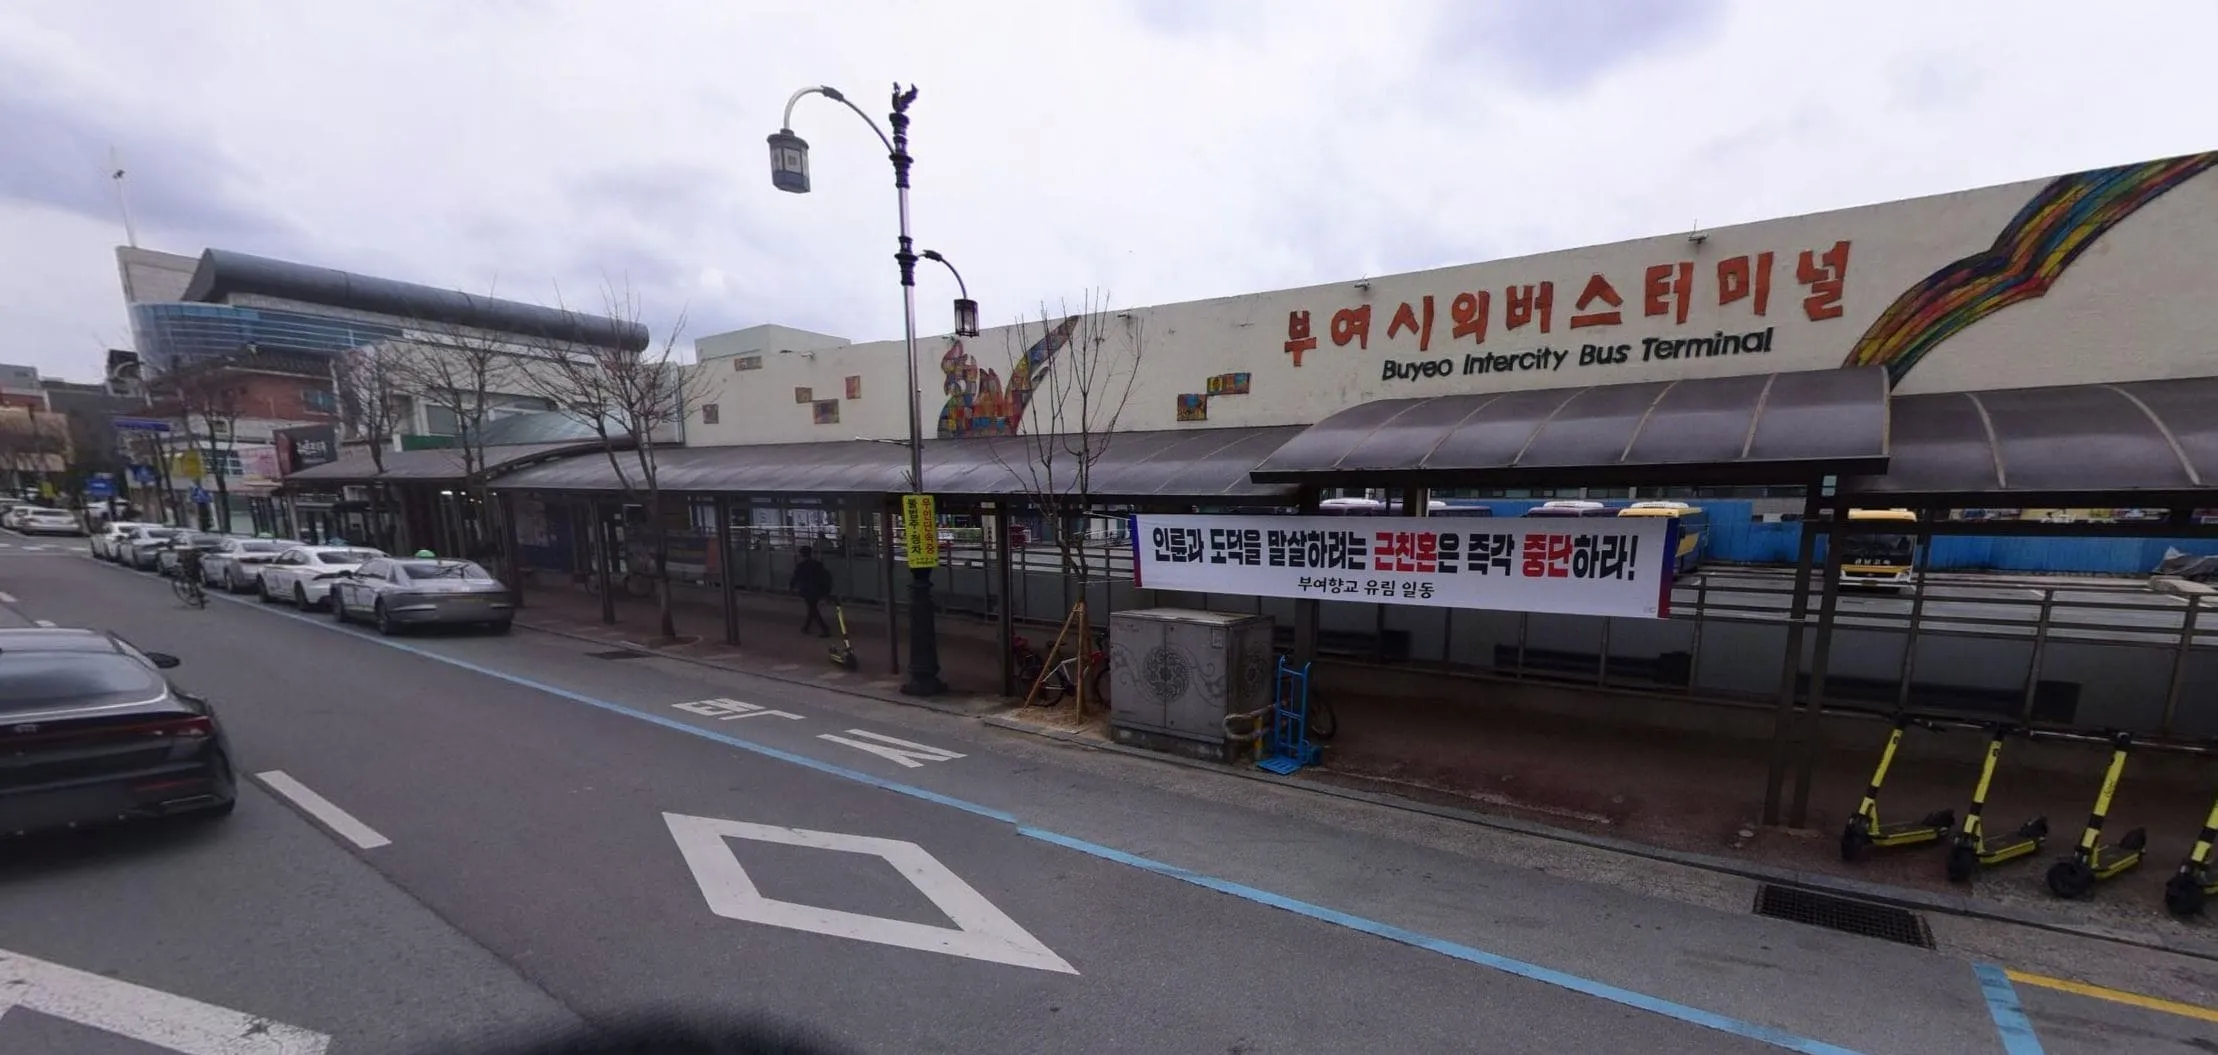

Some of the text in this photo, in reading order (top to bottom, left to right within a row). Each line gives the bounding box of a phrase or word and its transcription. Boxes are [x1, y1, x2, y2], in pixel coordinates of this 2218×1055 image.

[1284, 240, 1851, 367] 부여시외버스터미널
[1382, 327, 1774, 381] Buyeo Intercity Bus Terminal
[1152, 527, 1639, 581] 인륜과 도덕을 말살하려는 근친혼은 즉각 중단하라!
[1298, 576, 1435, 599] 부여향교 유림 일동
